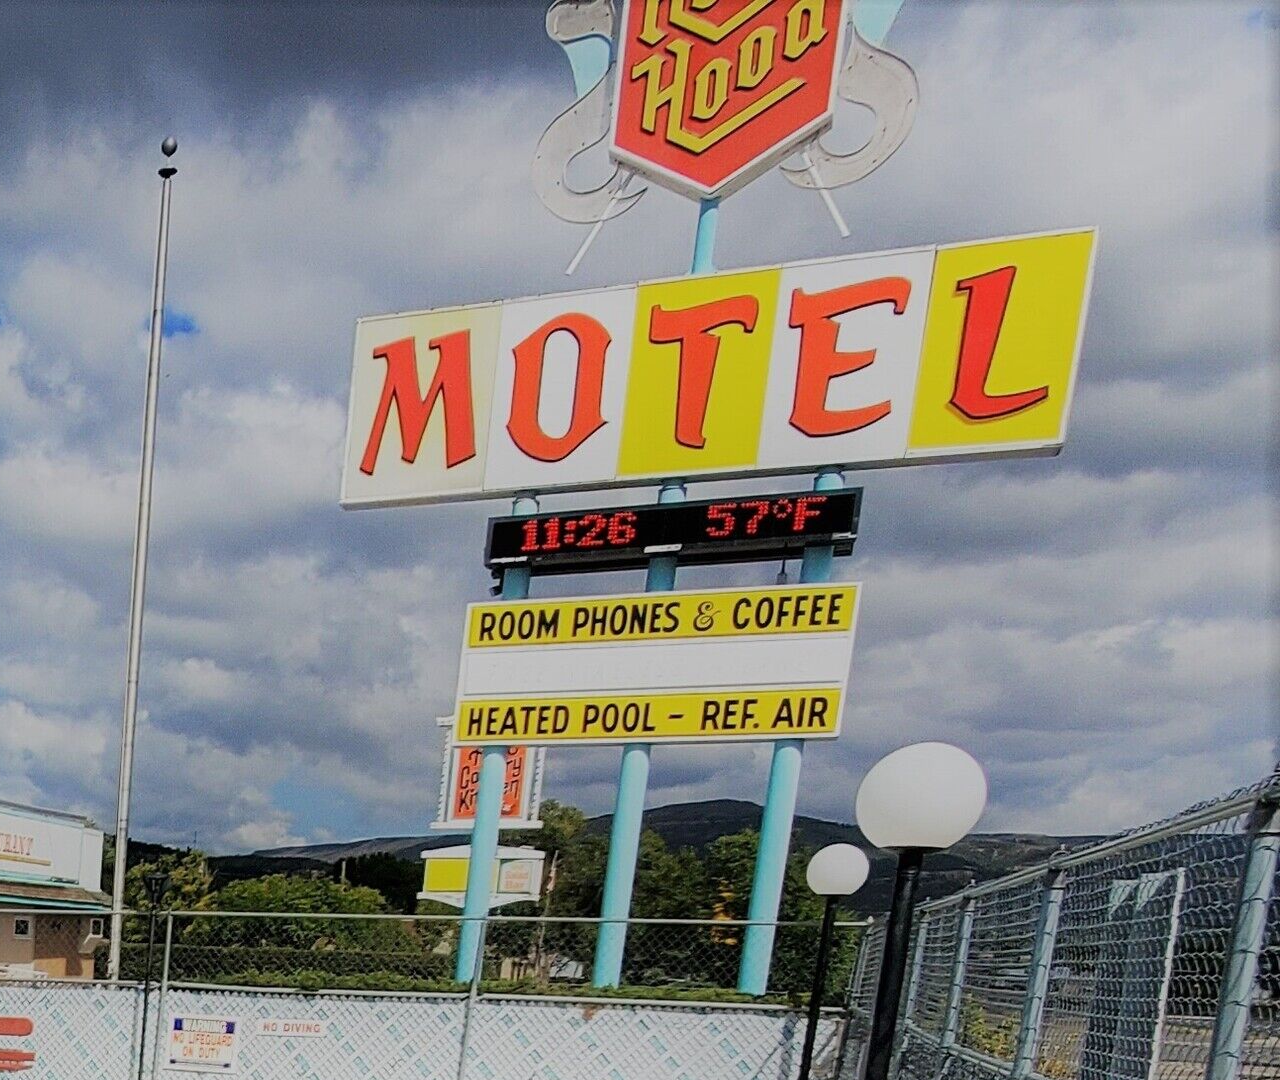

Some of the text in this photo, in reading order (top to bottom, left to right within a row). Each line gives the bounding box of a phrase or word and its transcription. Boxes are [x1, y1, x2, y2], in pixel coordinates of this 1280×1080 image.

[359, 266, 1049, 476] MOTEL
[521, 495, 828, 552] 11:26 57°F
[478, 593, 844, 642] ROOM PHONES & COFFEE
[466, 705, 570, 736] HEATED
[581, 702, 656, 733] POOL
[700, 699, 759, 730] REF.
[771, 697, 829, 729] AIR
[173, 1032, 233, 1047] NO LIFEGUARD
[263, 1022, 321, 1033] NO DIVING
